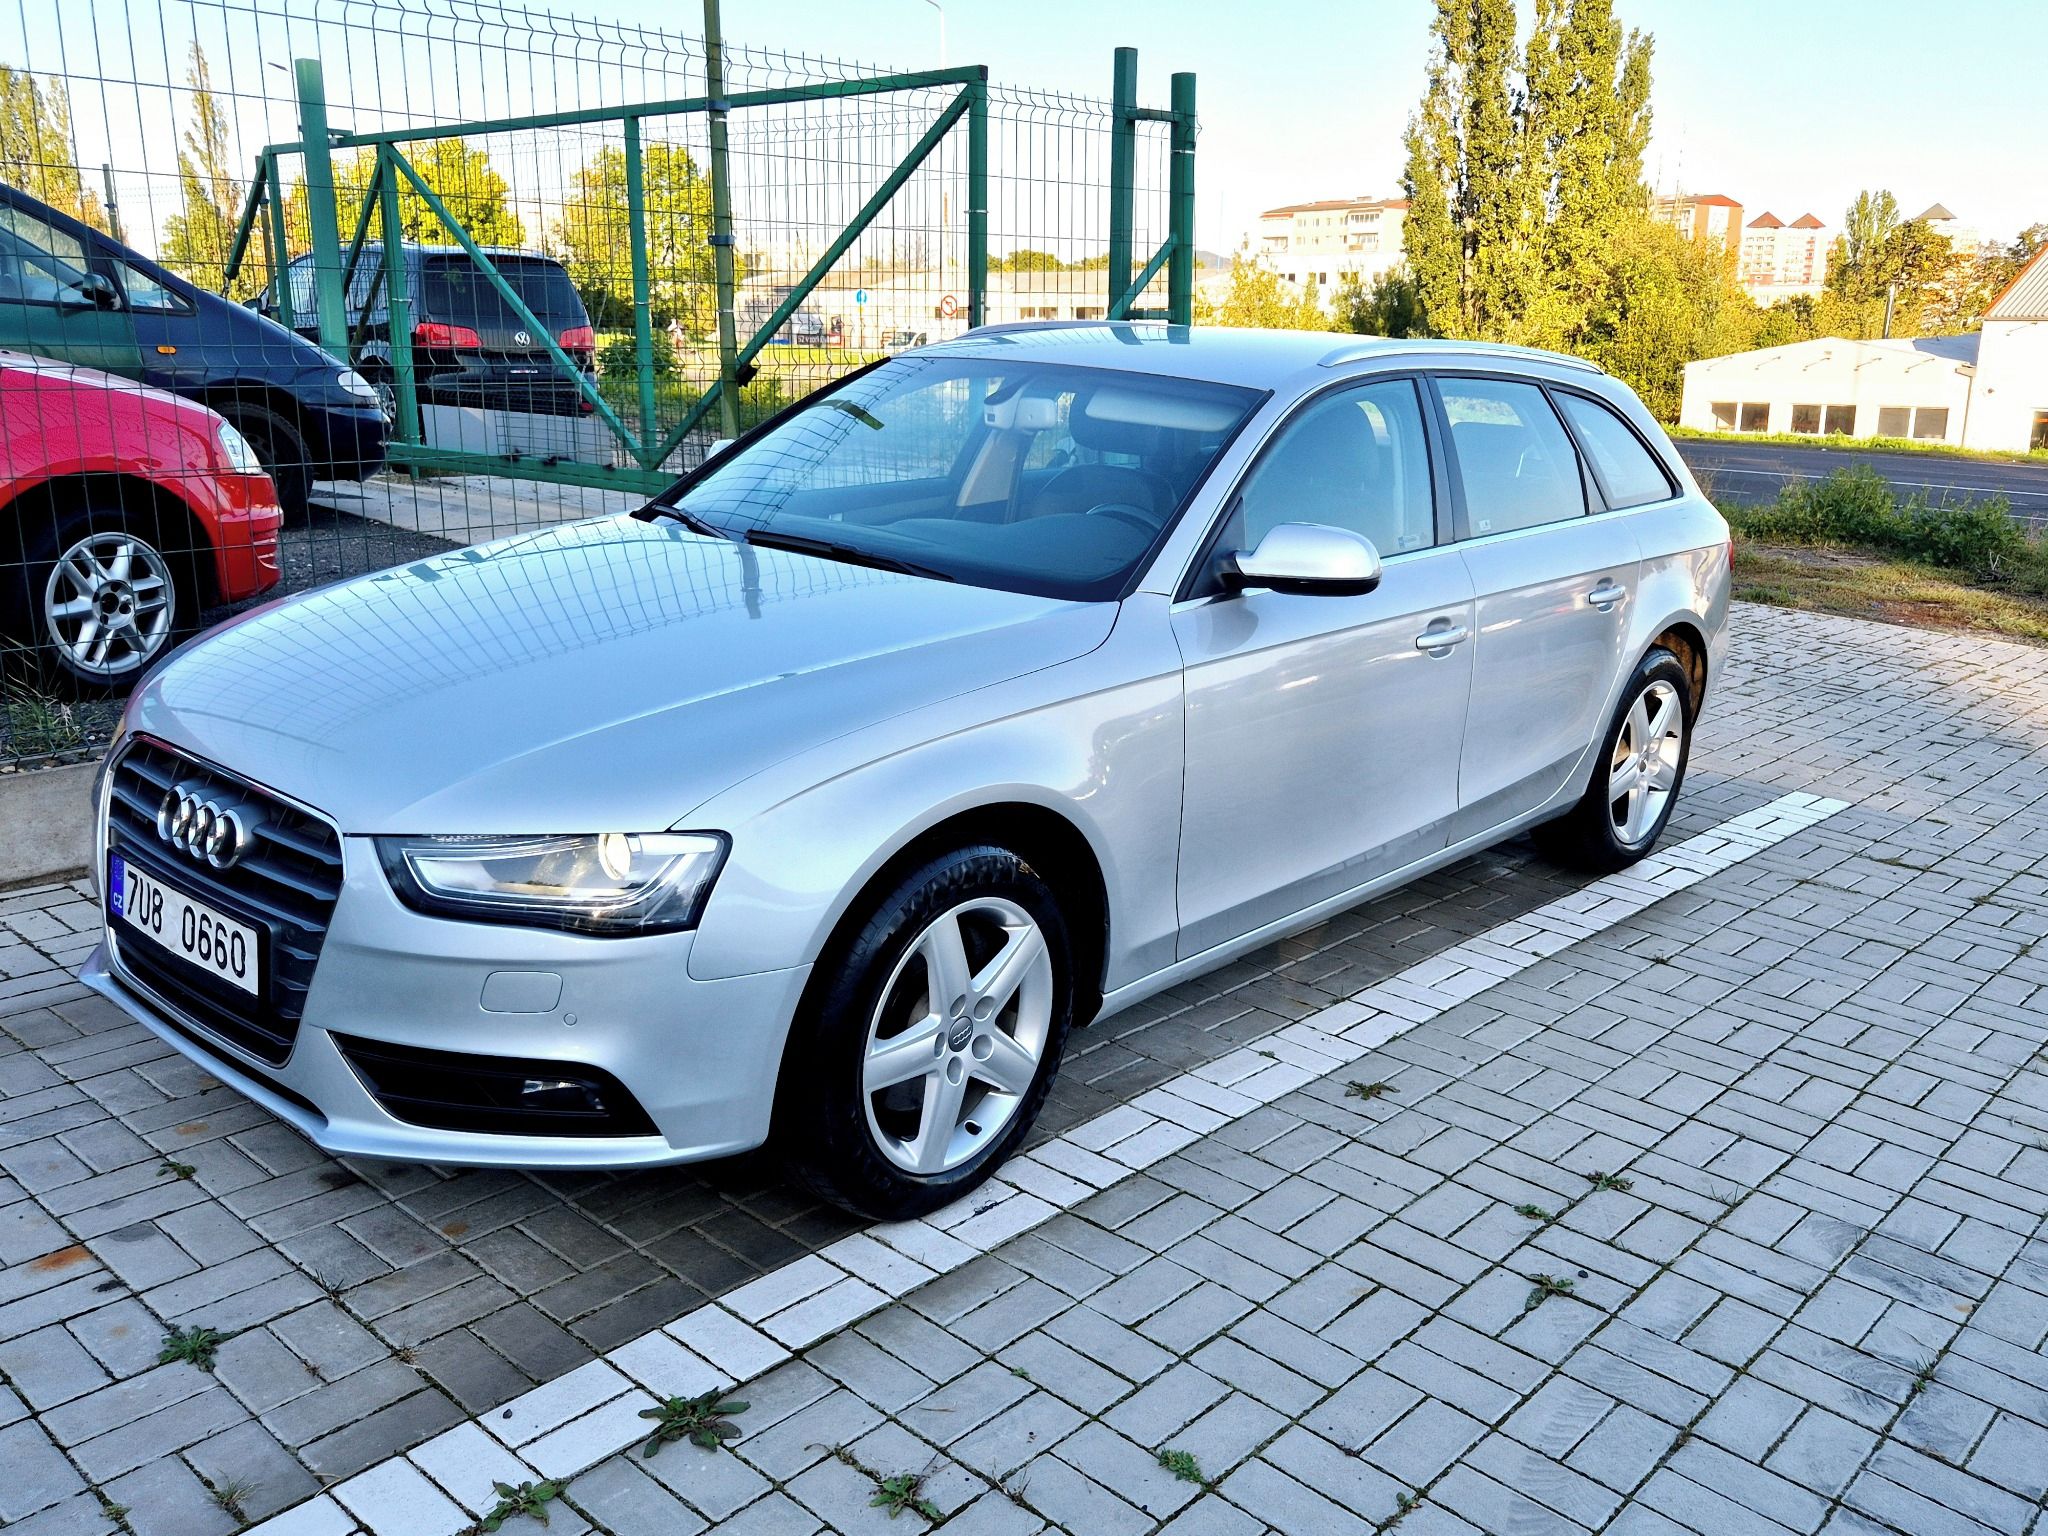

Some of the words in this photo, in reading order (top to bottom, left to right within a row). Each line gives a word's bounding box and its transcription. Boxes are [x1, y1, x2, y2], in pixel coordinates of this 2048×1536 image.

[113, 892, 123, 909] CZ
[127, 870, 163, 934] 7U8
[182, 905, 246, 978] 0660
